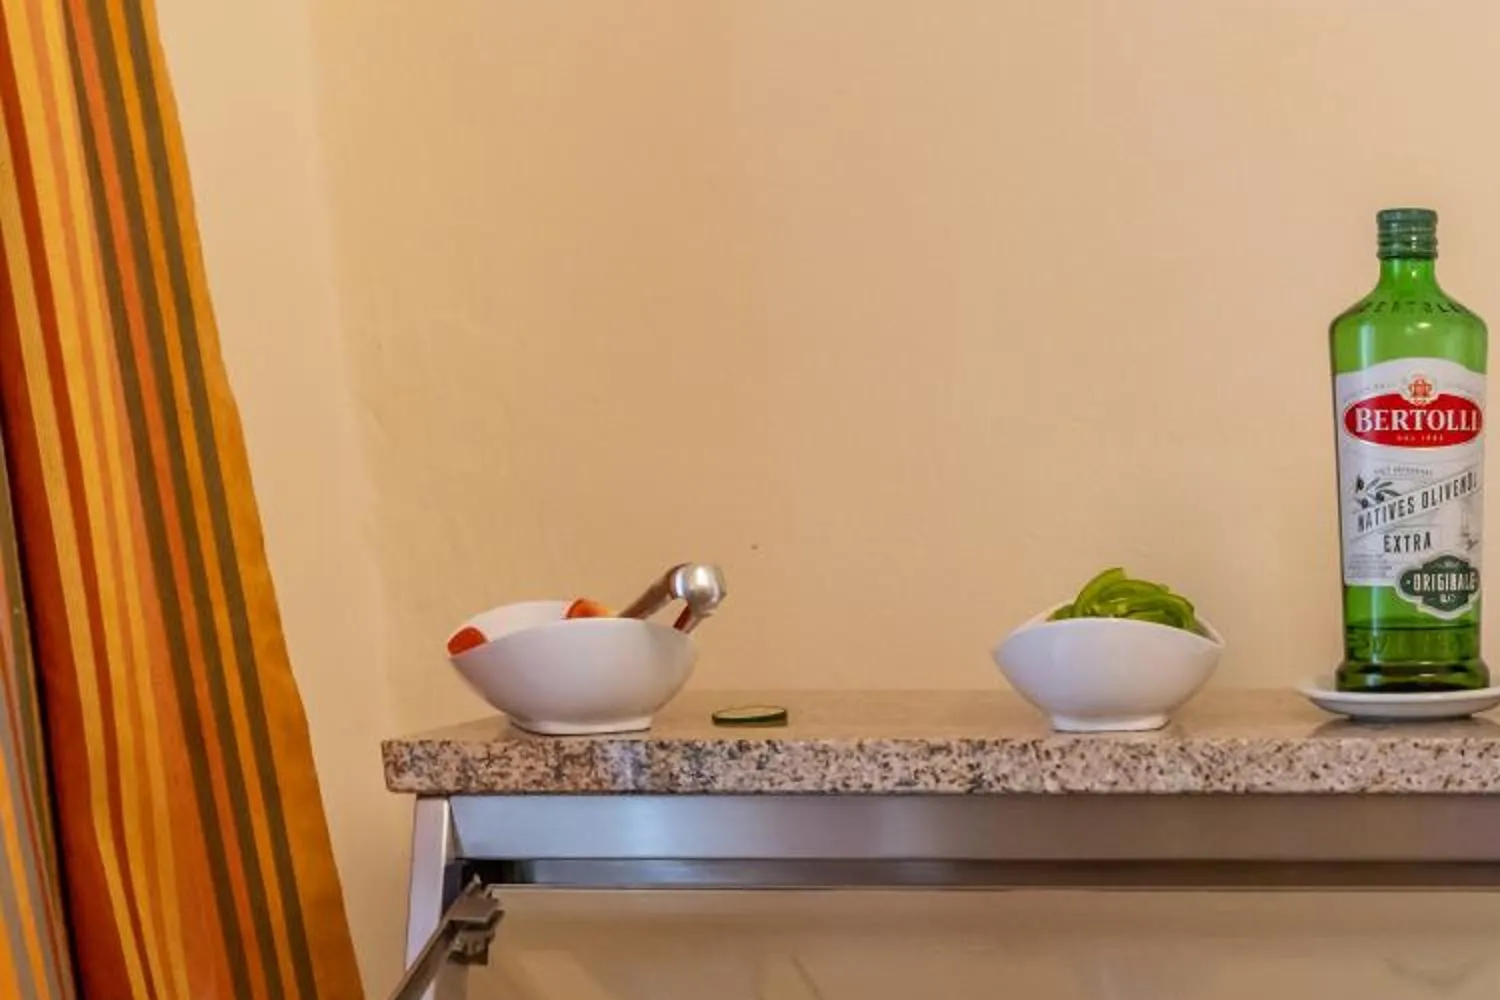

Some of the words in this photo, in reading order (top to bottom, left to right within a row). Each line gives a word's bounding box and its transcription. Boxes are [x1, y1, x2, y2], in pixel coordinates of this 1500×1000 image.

[1355, 407, 1478, 433] BERTOLLI
[1357, 495, 1415, 533] NATIVES
[1383, 531, 1431, 553] EXTRA
[1413, 570, 1476, 592] ORIGINALE
